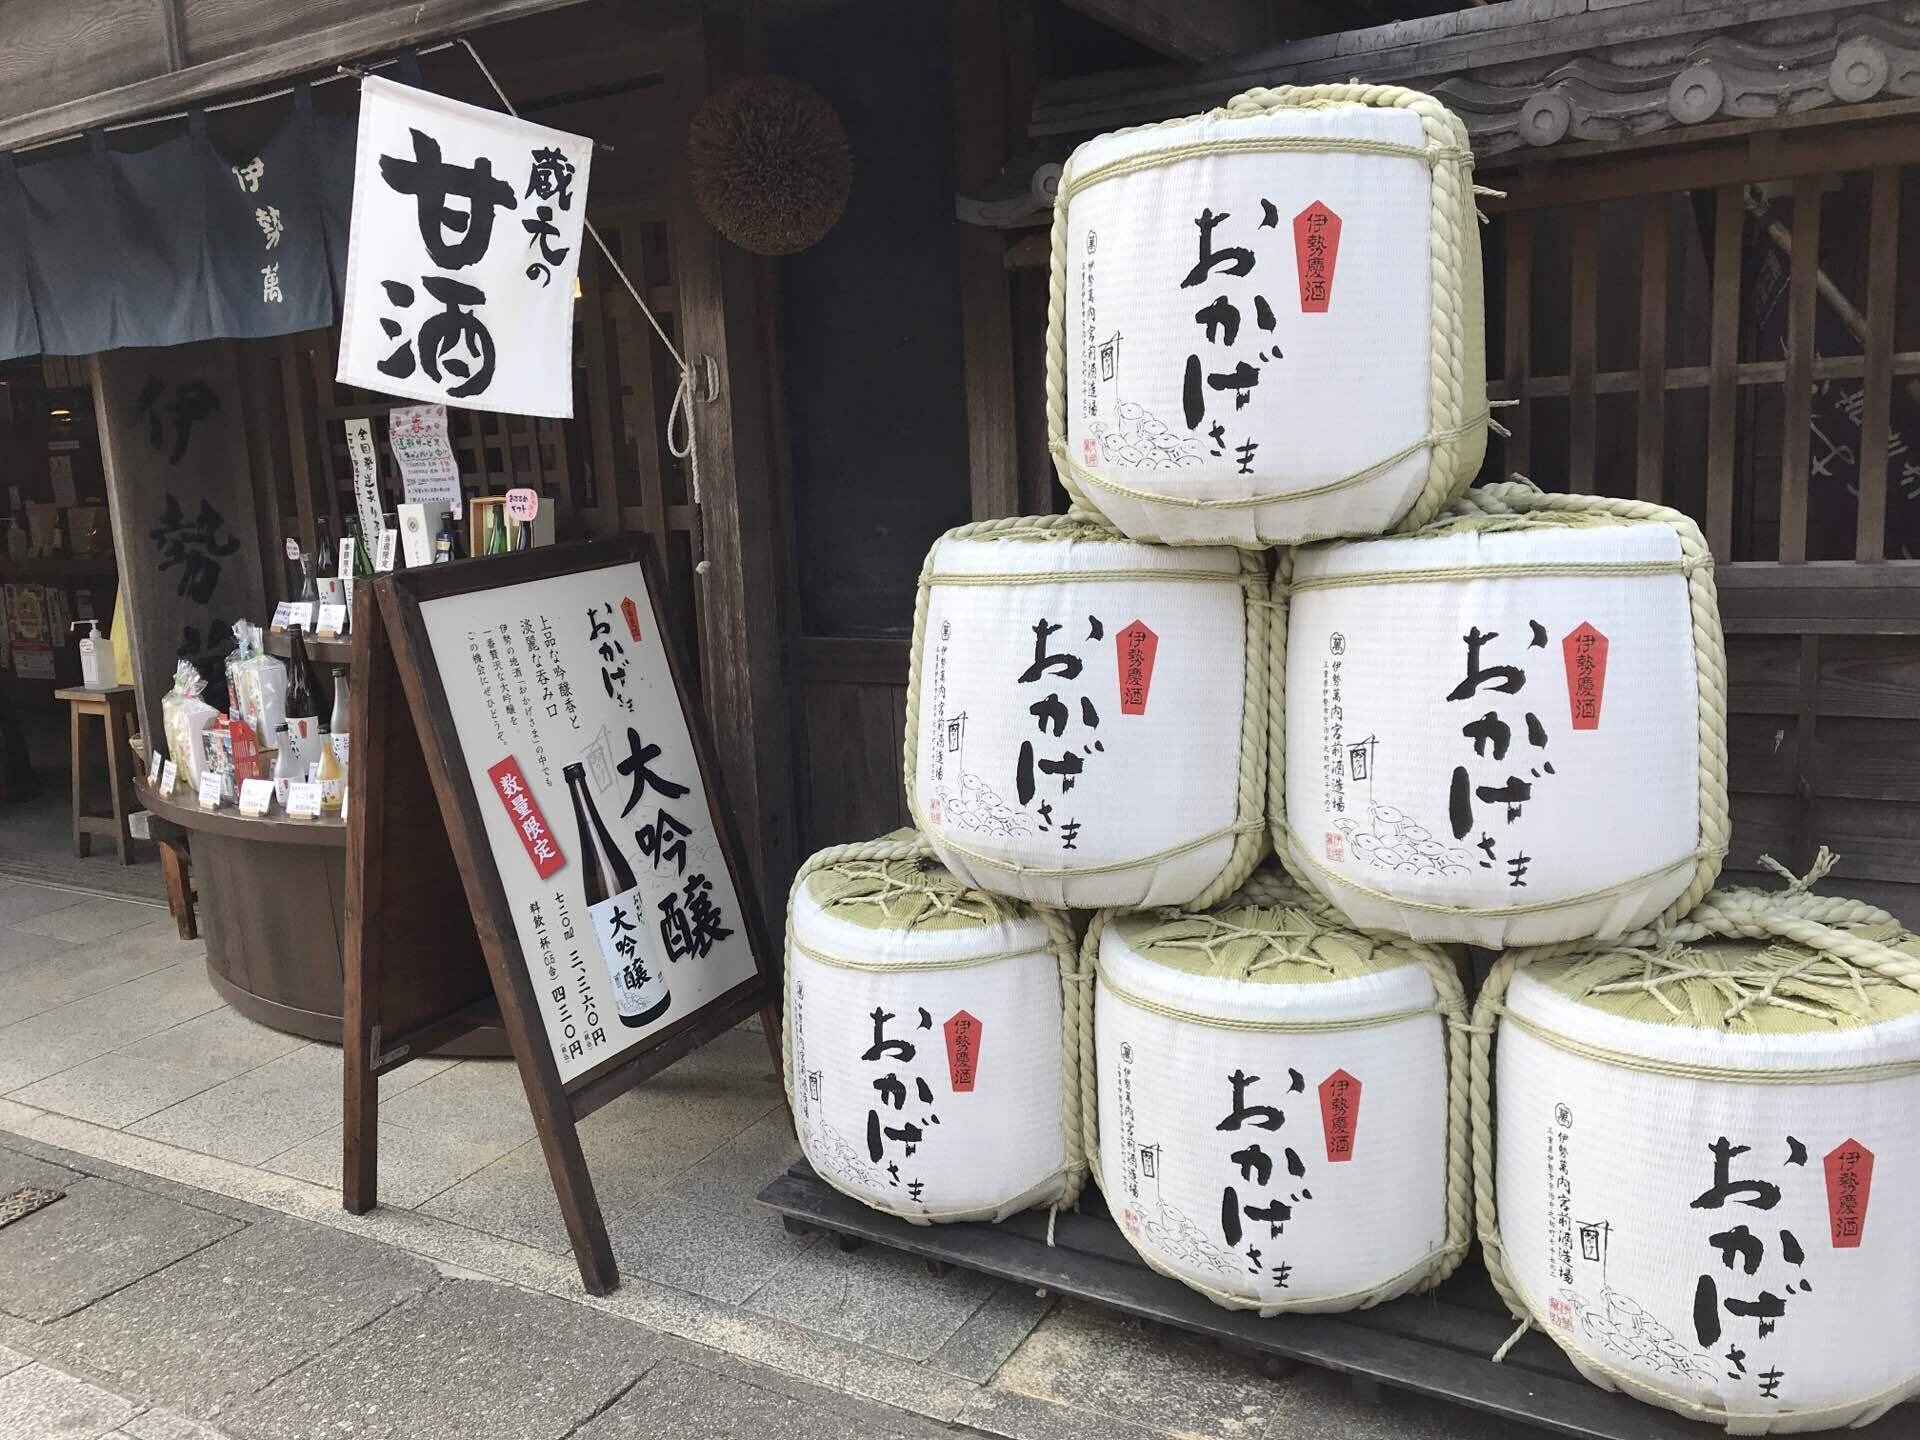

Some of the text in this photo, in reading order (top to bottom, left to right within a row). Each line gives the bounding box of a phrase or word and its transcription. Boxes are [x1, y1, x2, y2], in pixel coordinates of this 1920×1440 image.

[231, 157, 284, 303] 伊勢萬
[377, 128, 518, 398] 甘酒
[522, 147, 575, 288] 蔵元の
[1305, 213, 1328, 301] 伊勢慶酒
[1180, 198, 1283, 474] おかげさま
[520, 618, 558, 718] 淡麗な呑み口
[540, 615, 581, 730] 上品な吟醸香と
[586, 601, 636, 713] おかげさま
[1125, 631, 1146, 705] 伊勢慶酒
[1575, 634, 1596, 719] 伊勢慶酒
[1017, 615, 1104, 849] おかげさま
[1330, 660, 1345, 813] 伊勢萬内宮前酒造場
[1447, 620, 1555, 886] おかげさま
[501, 774, 556, 865] 数量限定
[617, 728, 734, 961] 大吟醸
[609, 905, 652, 991] 大吟醸
[862, 1007, 940, 1203] おかげさま
[954, 1019, 971, 1084] 伊勢慶酒
[1330, 1080, 1350, 1152] 伊勢慶酒
[1216, 1068, 1312, 1288] おかげさま
[1557, 1132, 1574, 1285] 伊勢萬内宮前酒造場
[1836, 1152, 1860, 1237] 伊勢慶酒
[1690, 1136, 1812, 1399] おかげさま
